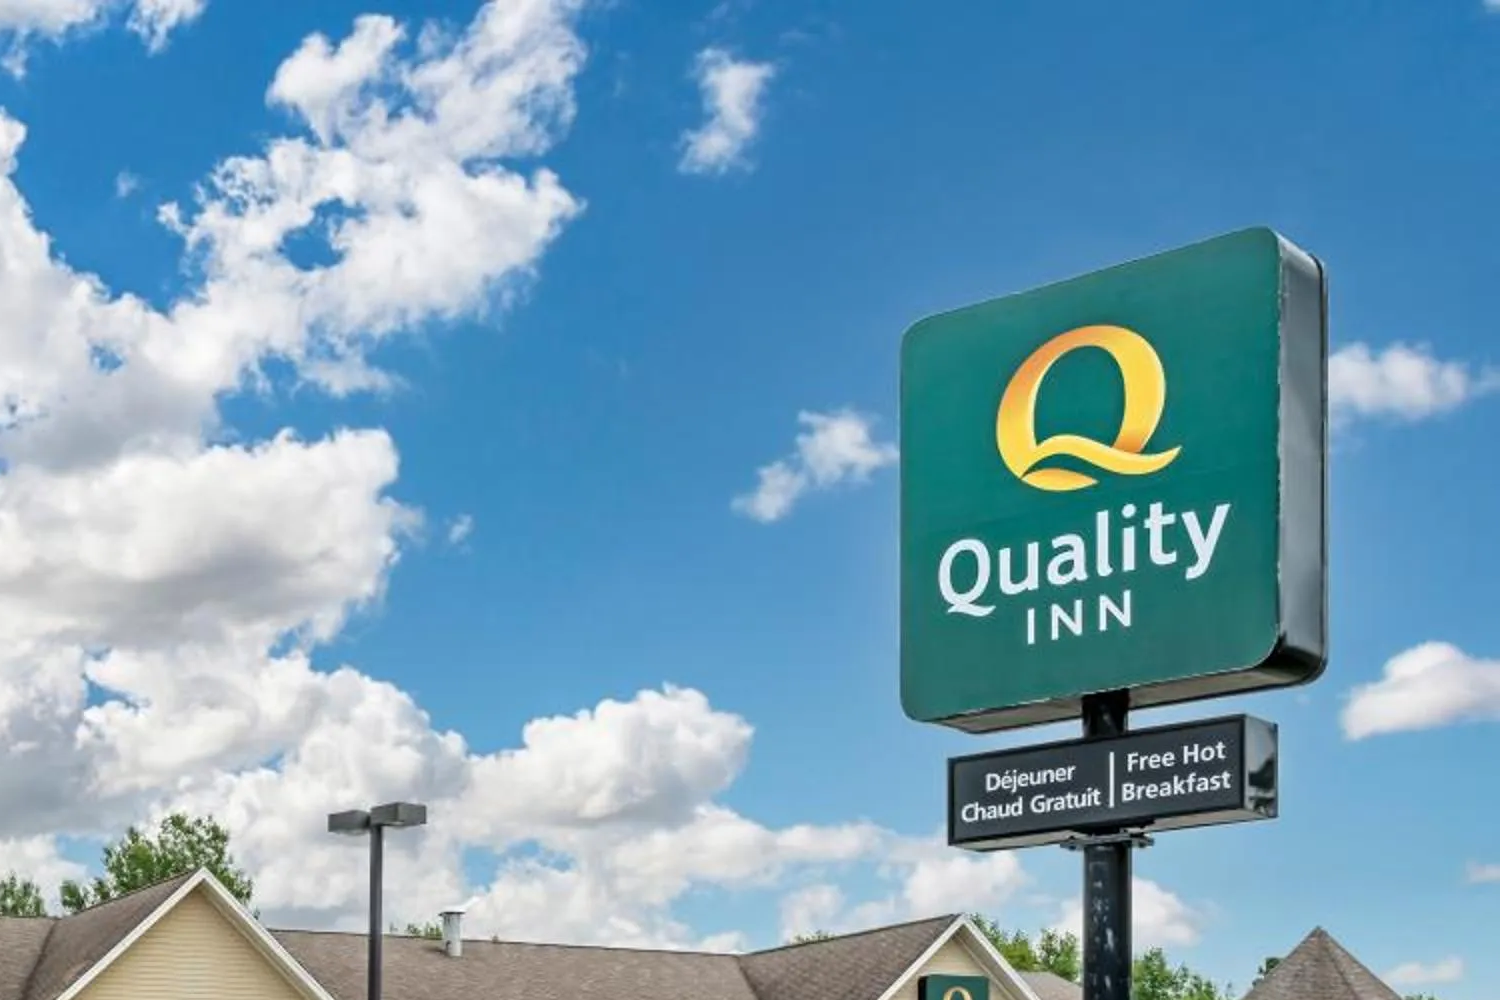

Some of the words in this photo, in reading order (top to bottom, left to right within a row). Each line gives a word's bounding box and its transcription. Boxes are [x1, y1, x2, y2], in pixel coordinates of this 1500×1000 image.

[937, 503, 1230, 617] Quality
[1026, 590, 1133, 644] INN
[1127, 752, 1176, 772] Free
[1183, 741, 1227, 765] Hot
[985, 764, 1076, 795] Déjeuner
[1122, 771, 1232, 802] Breakfast
[961, 797, 1023, 823] Chaud
[1030, 788, 1101, 814] Gratuit
